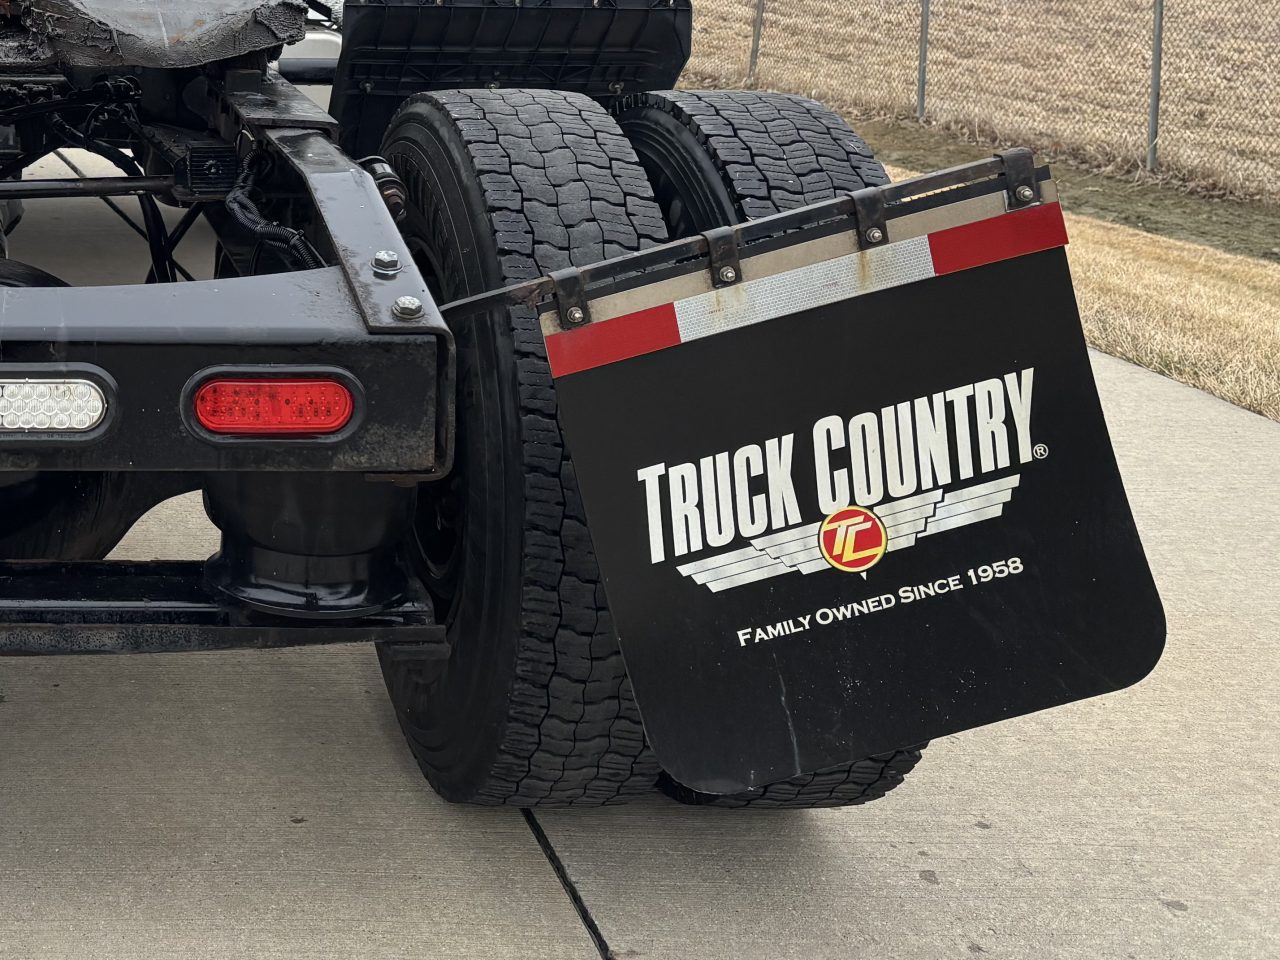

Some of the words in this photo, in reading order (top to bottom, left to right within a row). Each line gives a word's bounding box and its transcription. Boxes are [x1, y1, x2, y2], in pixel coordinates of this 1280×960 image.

[637, 433, 803, 565] TRUCK
[813, 368, 1035, 515] COUNTRY
[966, 557, 1024, 587] 1958
